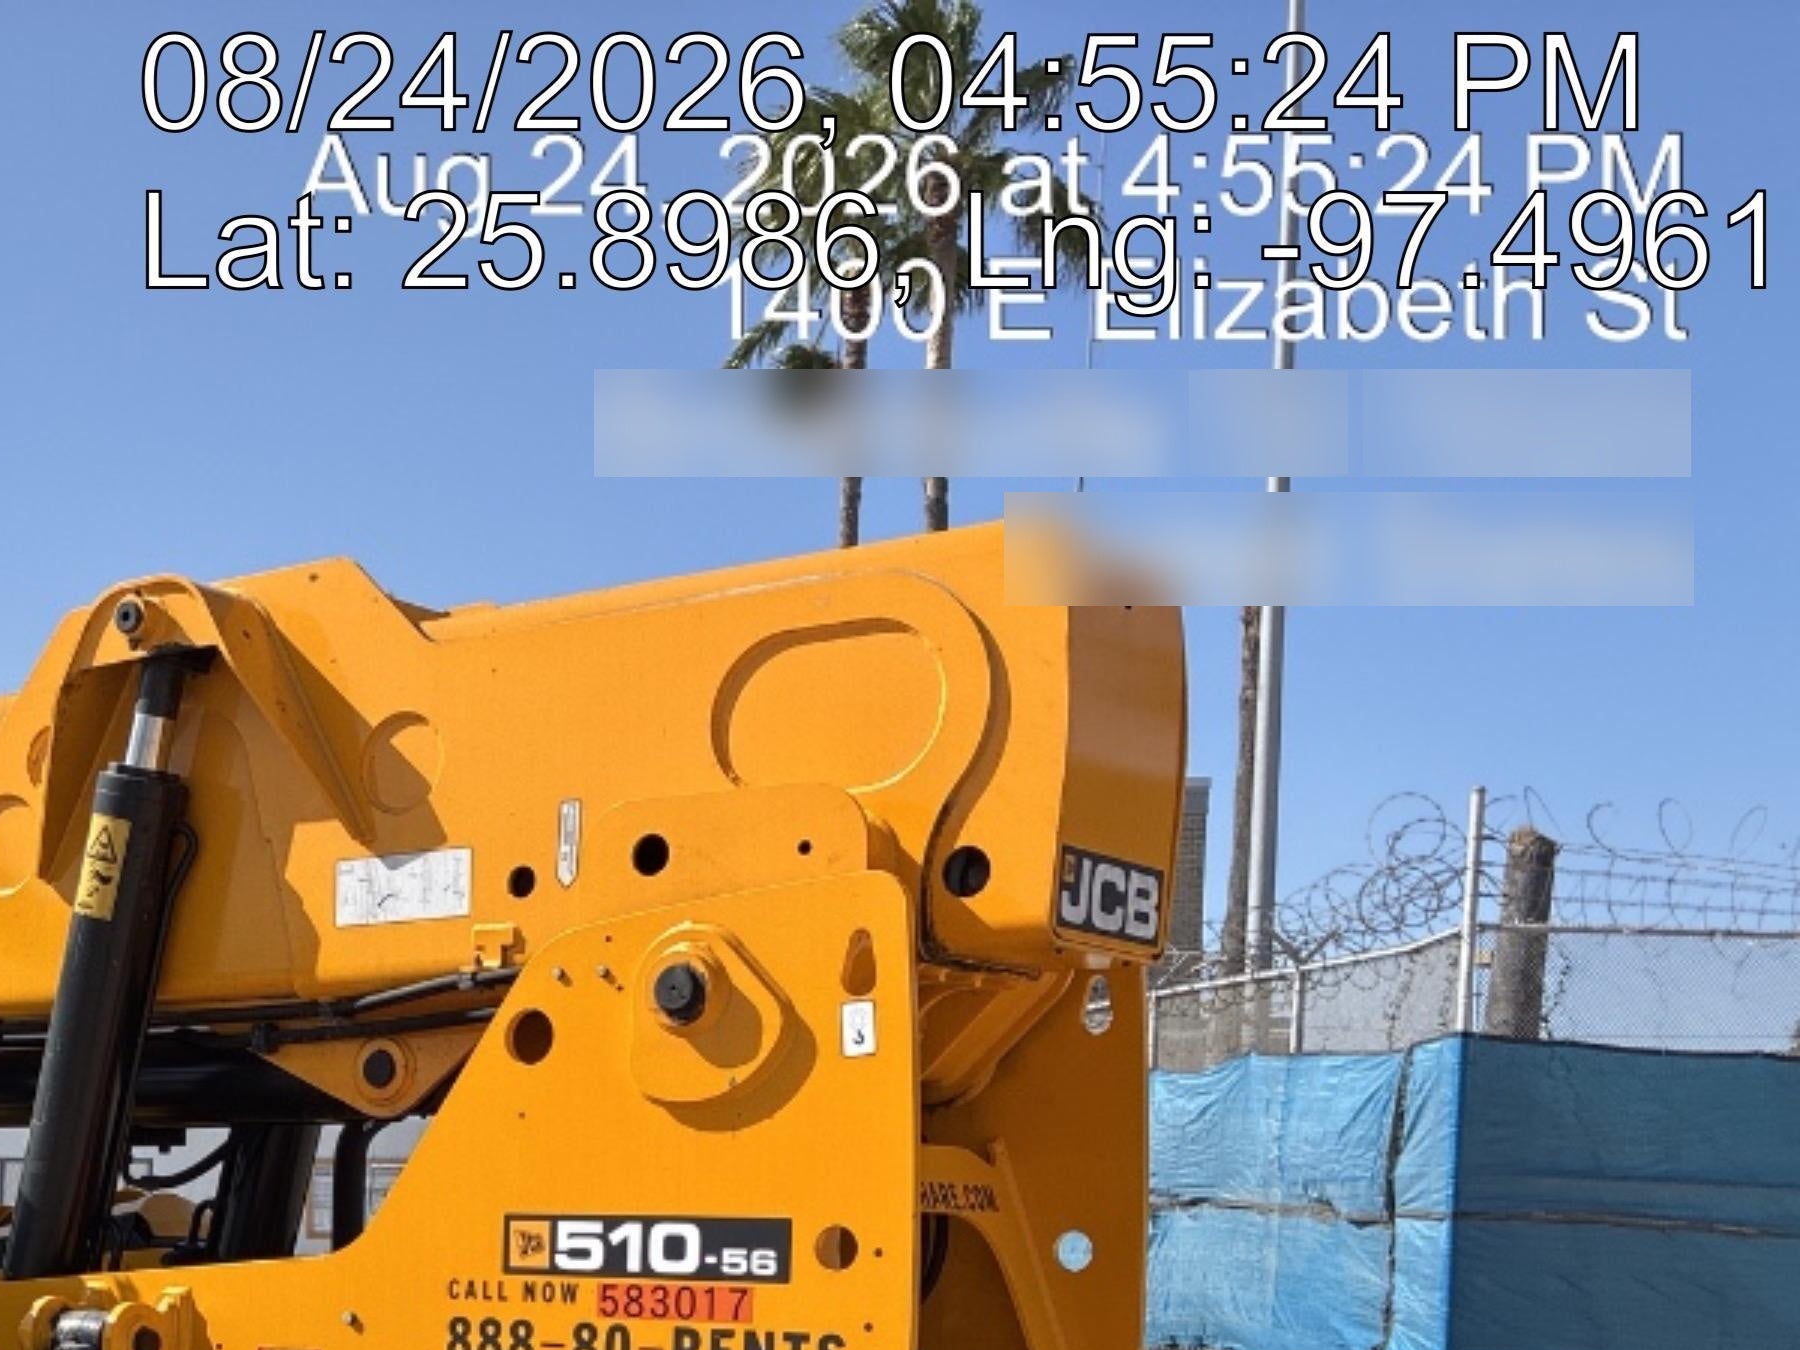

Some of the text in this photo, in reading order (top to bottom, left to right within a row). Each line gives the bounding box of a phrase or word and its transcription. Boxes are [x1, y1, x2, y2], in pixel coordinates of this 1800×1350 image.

[1061, 858, 1159, 939] JCB
[448, 1279, 579, 1304] CALL NOW
[600, 1284, 749, 1321] 583017
